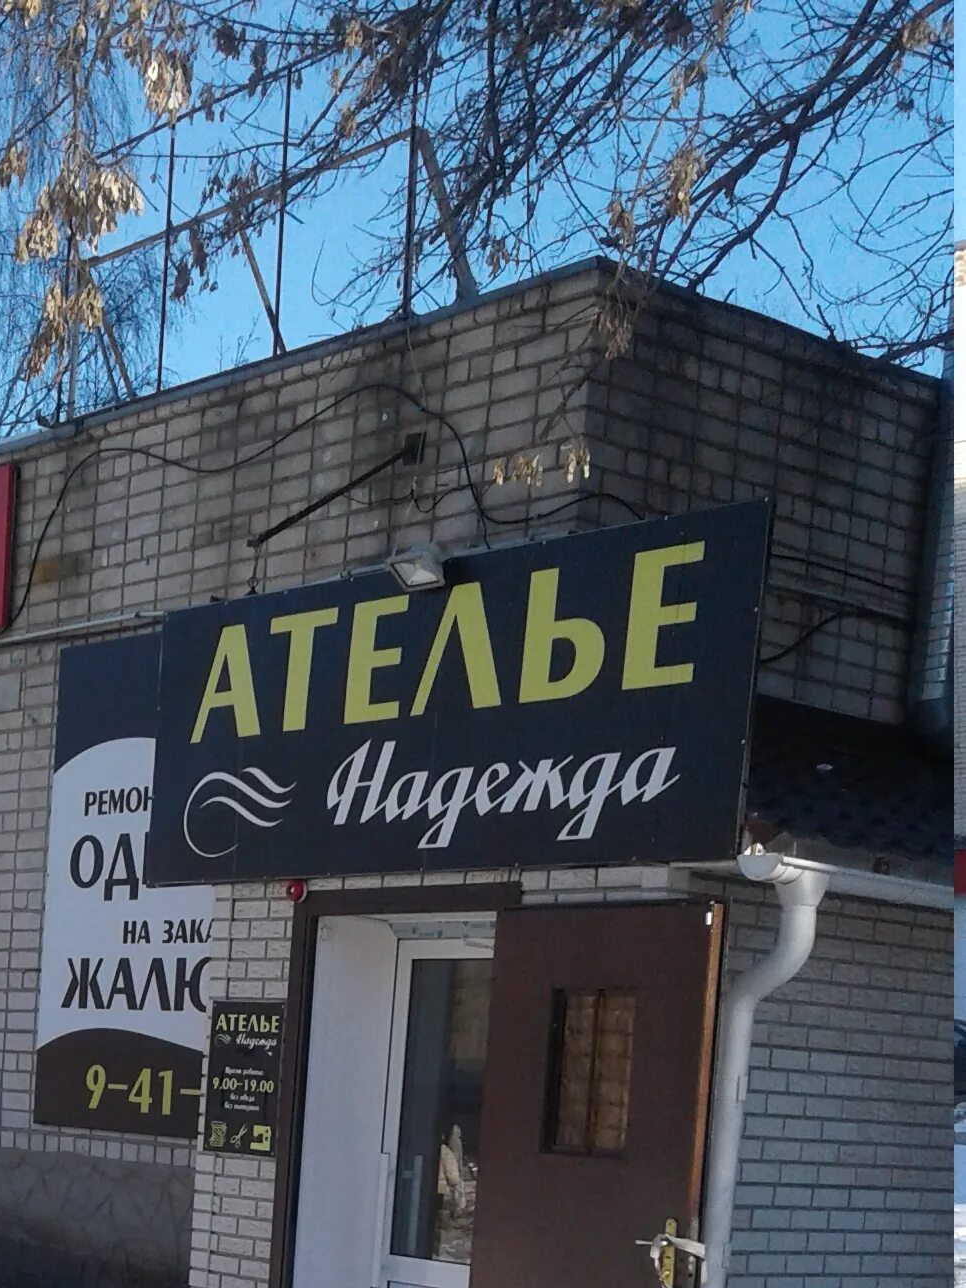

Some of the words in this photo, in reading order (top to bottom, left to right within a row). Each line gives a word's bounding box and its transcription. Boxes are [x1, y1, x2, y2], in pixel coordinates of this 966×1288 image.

[190, 540, 706, 744] АТЕЛЬЕ
[326, 739, 681, 850] Надежда
[122, 920, 151, 944] НА
[215, 1013, 280, 1033] АТЕЛЬЕ
[212, 1077, 275, 1093] 9.00-19.00
